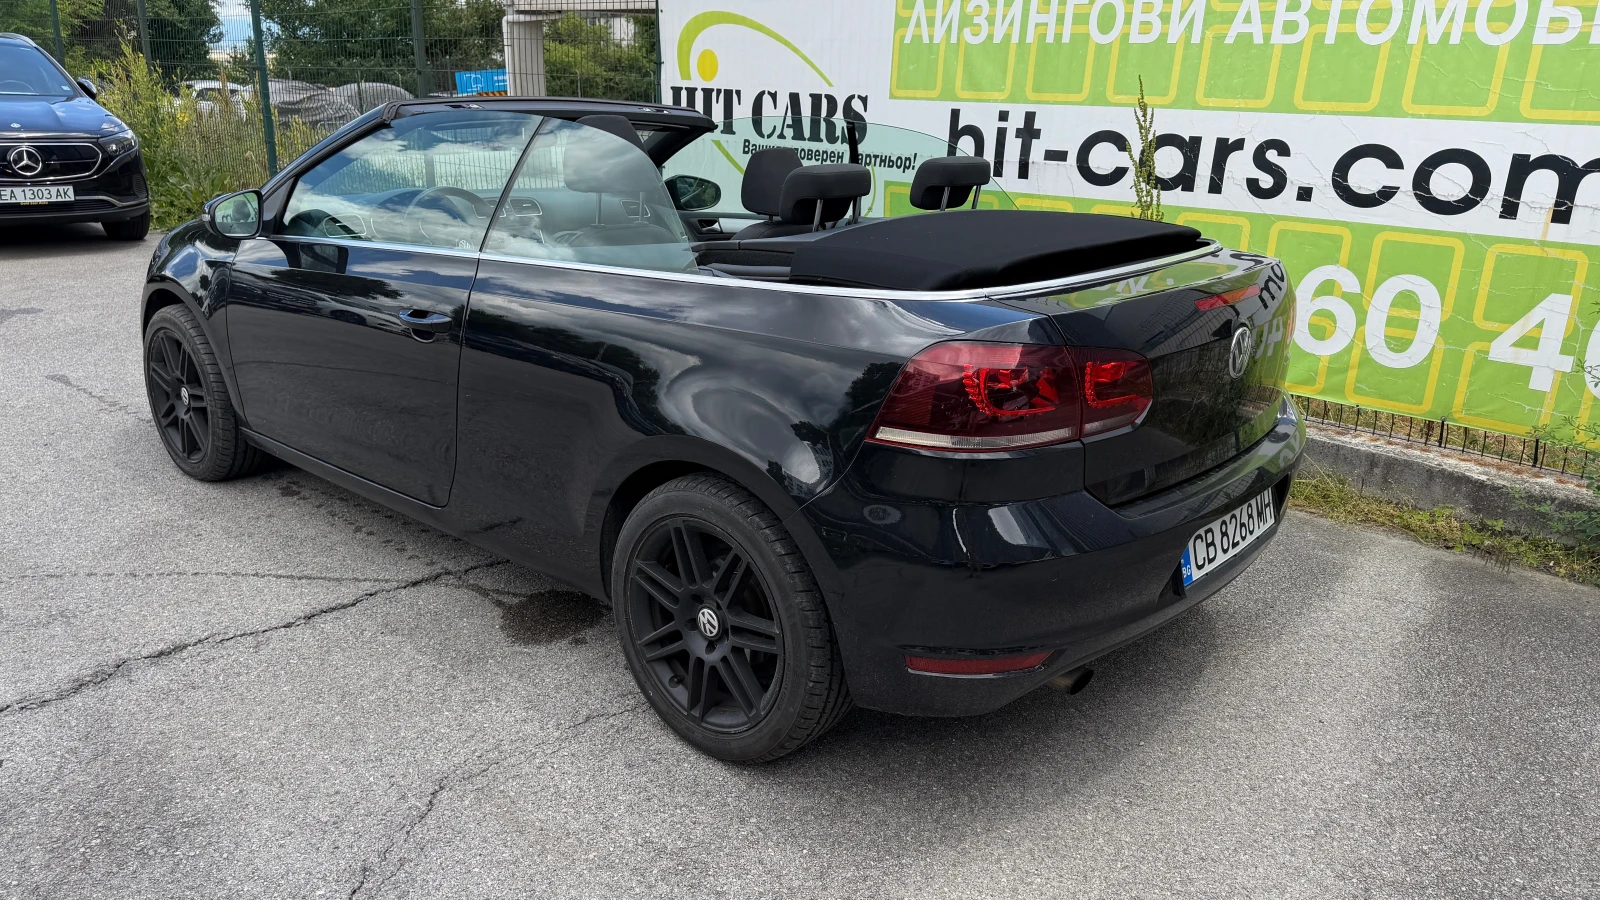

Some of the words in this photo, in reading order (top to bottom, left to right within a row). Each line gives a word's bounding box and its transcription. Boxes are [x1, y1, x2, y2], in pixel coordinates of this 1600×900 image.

[904, 0, 1205, 44] ЛИЗИНГОВИ
[1223, 0, 1600, 46] АВТОМОБ
[751, 90, 869, 146] CARS
[857, 152, 918, 174] артньор!
[946, 108, 1600, 225] hit-cars.com
[20, 188, 53, 200] 1303
[55, 187, 72, 200] AK
[1293, 264, 1442, 369] 60
[1488, 292, 1600, 400] 4
[1193, 526, 1218, 571] CB
[1219, 501, 1255, 555] 8268
[1182, 564, 1192, 579] BG
